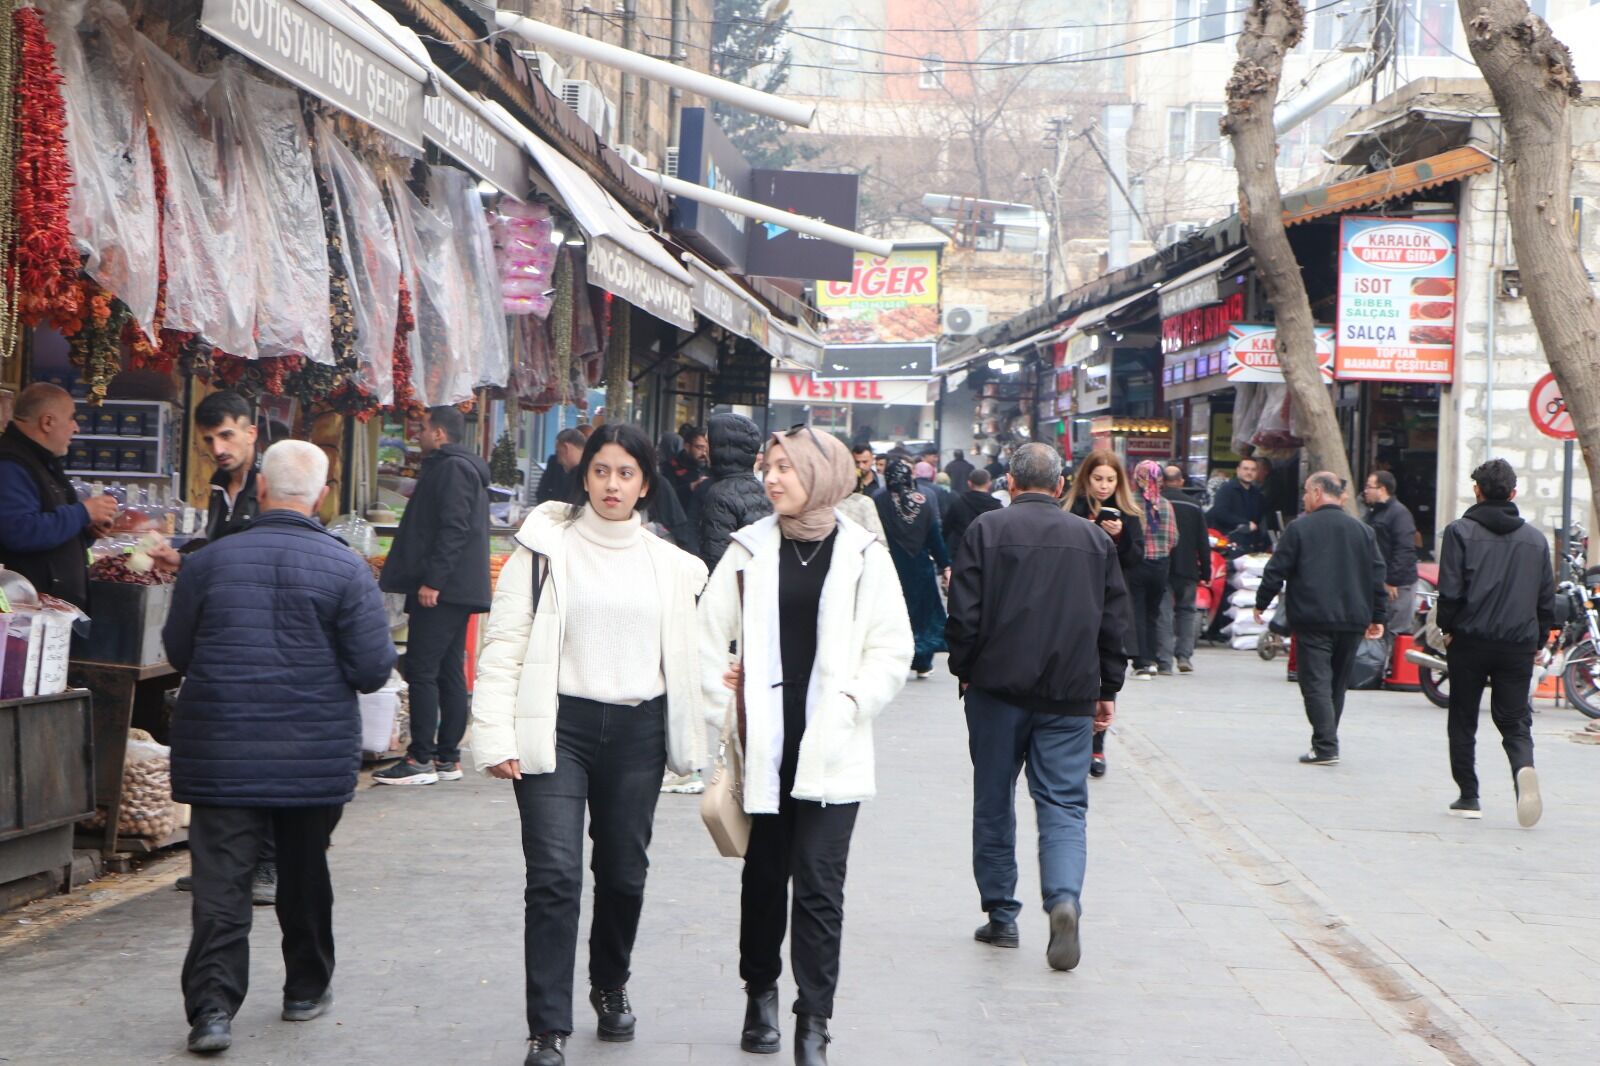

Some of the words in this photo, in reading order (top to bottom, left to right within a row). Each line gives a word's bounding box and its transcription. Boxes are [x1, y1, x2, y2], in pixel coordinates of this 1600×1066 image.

[328, 26, 364, 100] İSOT
[367, 63, 409, 129] ŞEHRİ
[473, 115, 497, 172] İSOT
[1368, 232, 1432, 247] KARALÖK
[1361, 248, 1403, 261] OKTAY
[1347, 325, 1397, 344] SALÇA
[1245, 352, 1280, 366] OKTA
[1376, 347, 1417, 358] TOPTAN
[1343, 358, 1392, 369] BAHARAT
[788, 375, 883, 400] VESTEL
